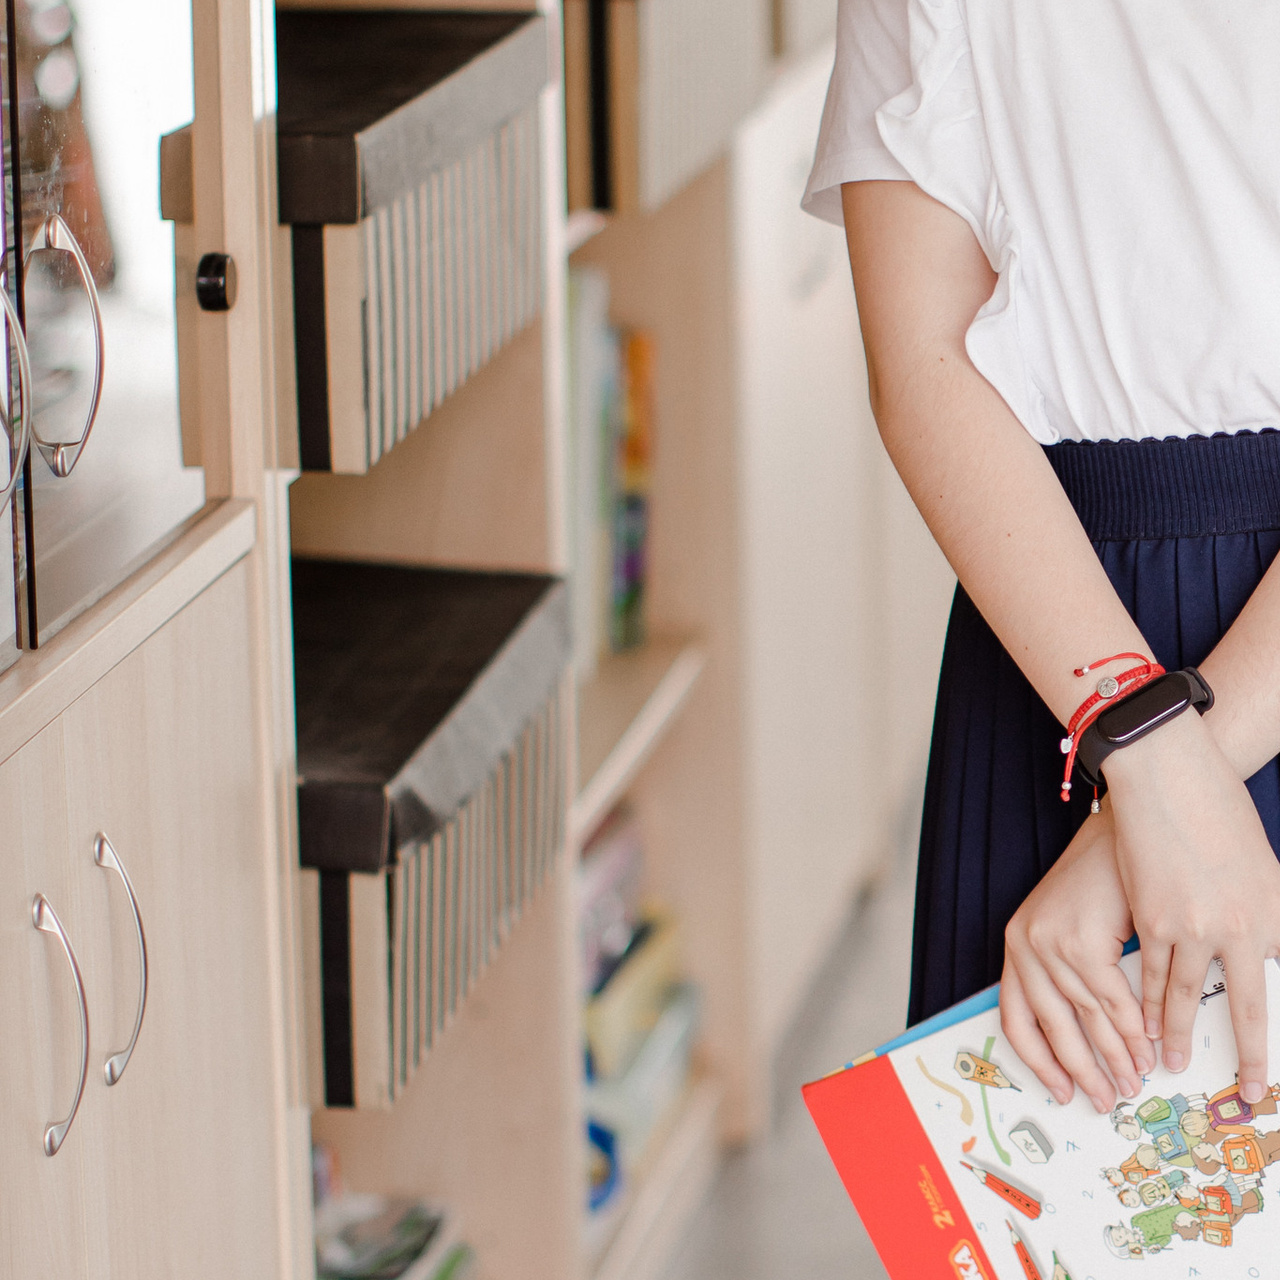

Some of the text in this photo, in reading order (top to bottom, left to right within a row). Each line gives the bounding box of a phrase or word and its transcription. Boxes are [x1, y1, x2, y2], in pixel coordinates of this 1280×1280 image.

[1161, 1137, 1172, 1148] 2
[1233, 1154, 1245, 1166] 3
[932, 1209, 955, 1228] 2
